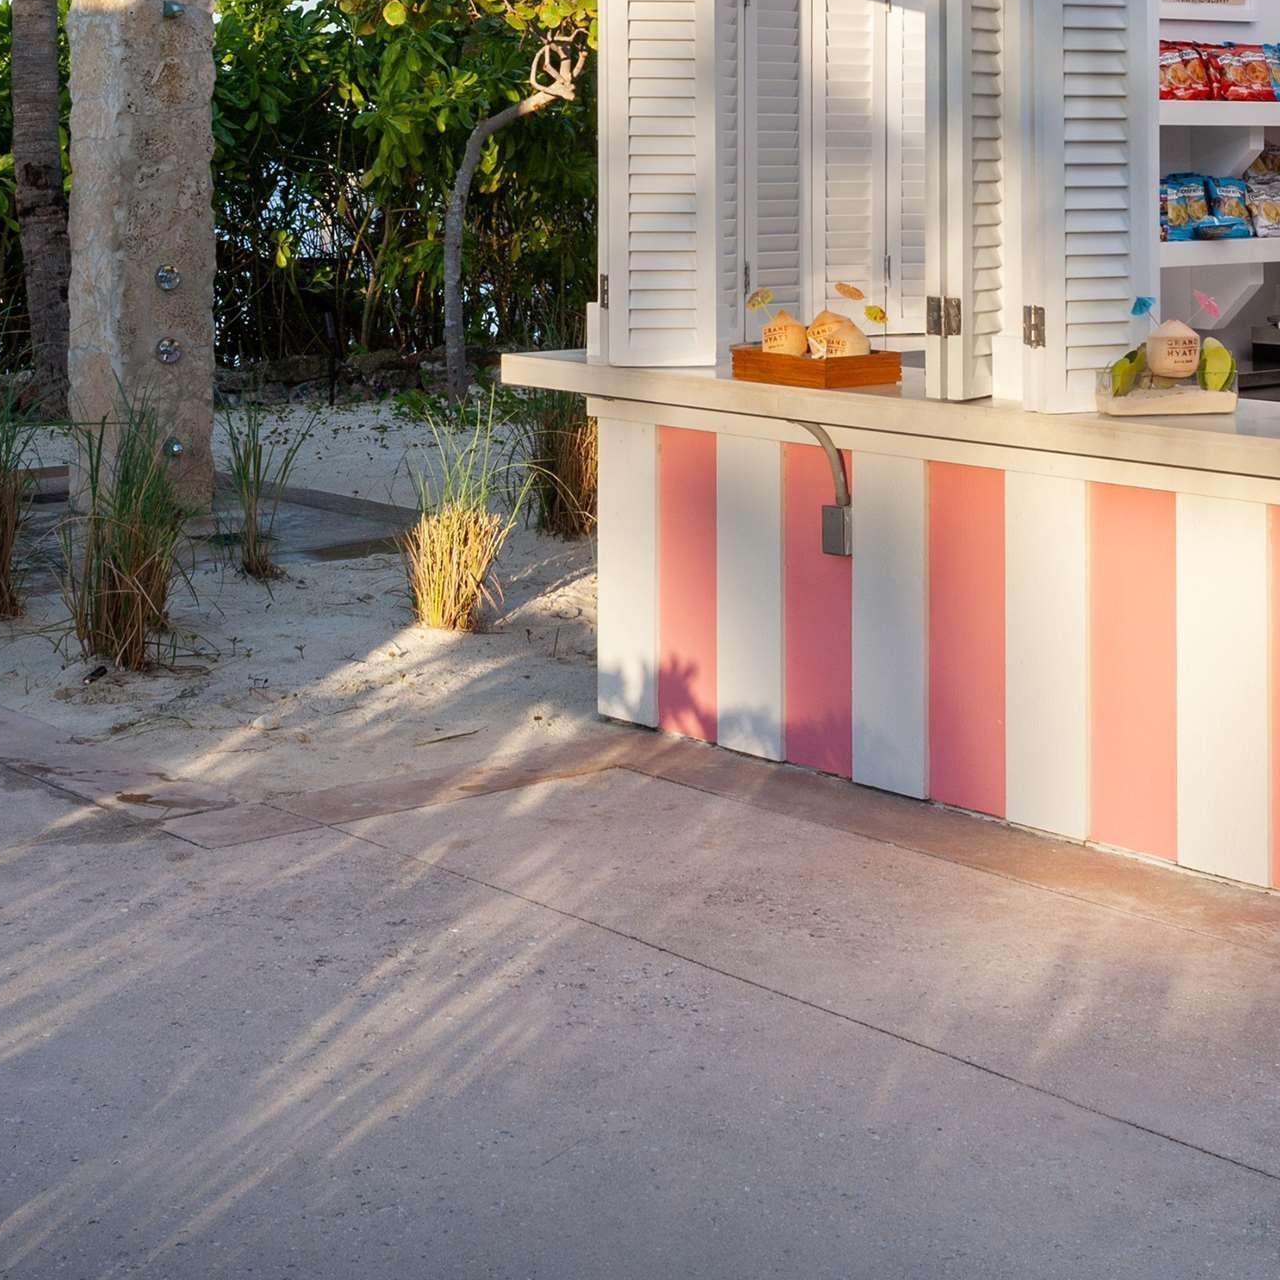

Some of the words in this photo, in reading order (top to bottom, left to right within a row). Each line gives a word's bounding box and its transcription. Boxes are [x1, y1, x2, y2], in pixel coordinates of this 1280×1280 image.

[764, 334, 788, 345] HYATT
[1167, 338, 1199, 346] GRAND
[1167, 349, 1198, 357] HYATT
